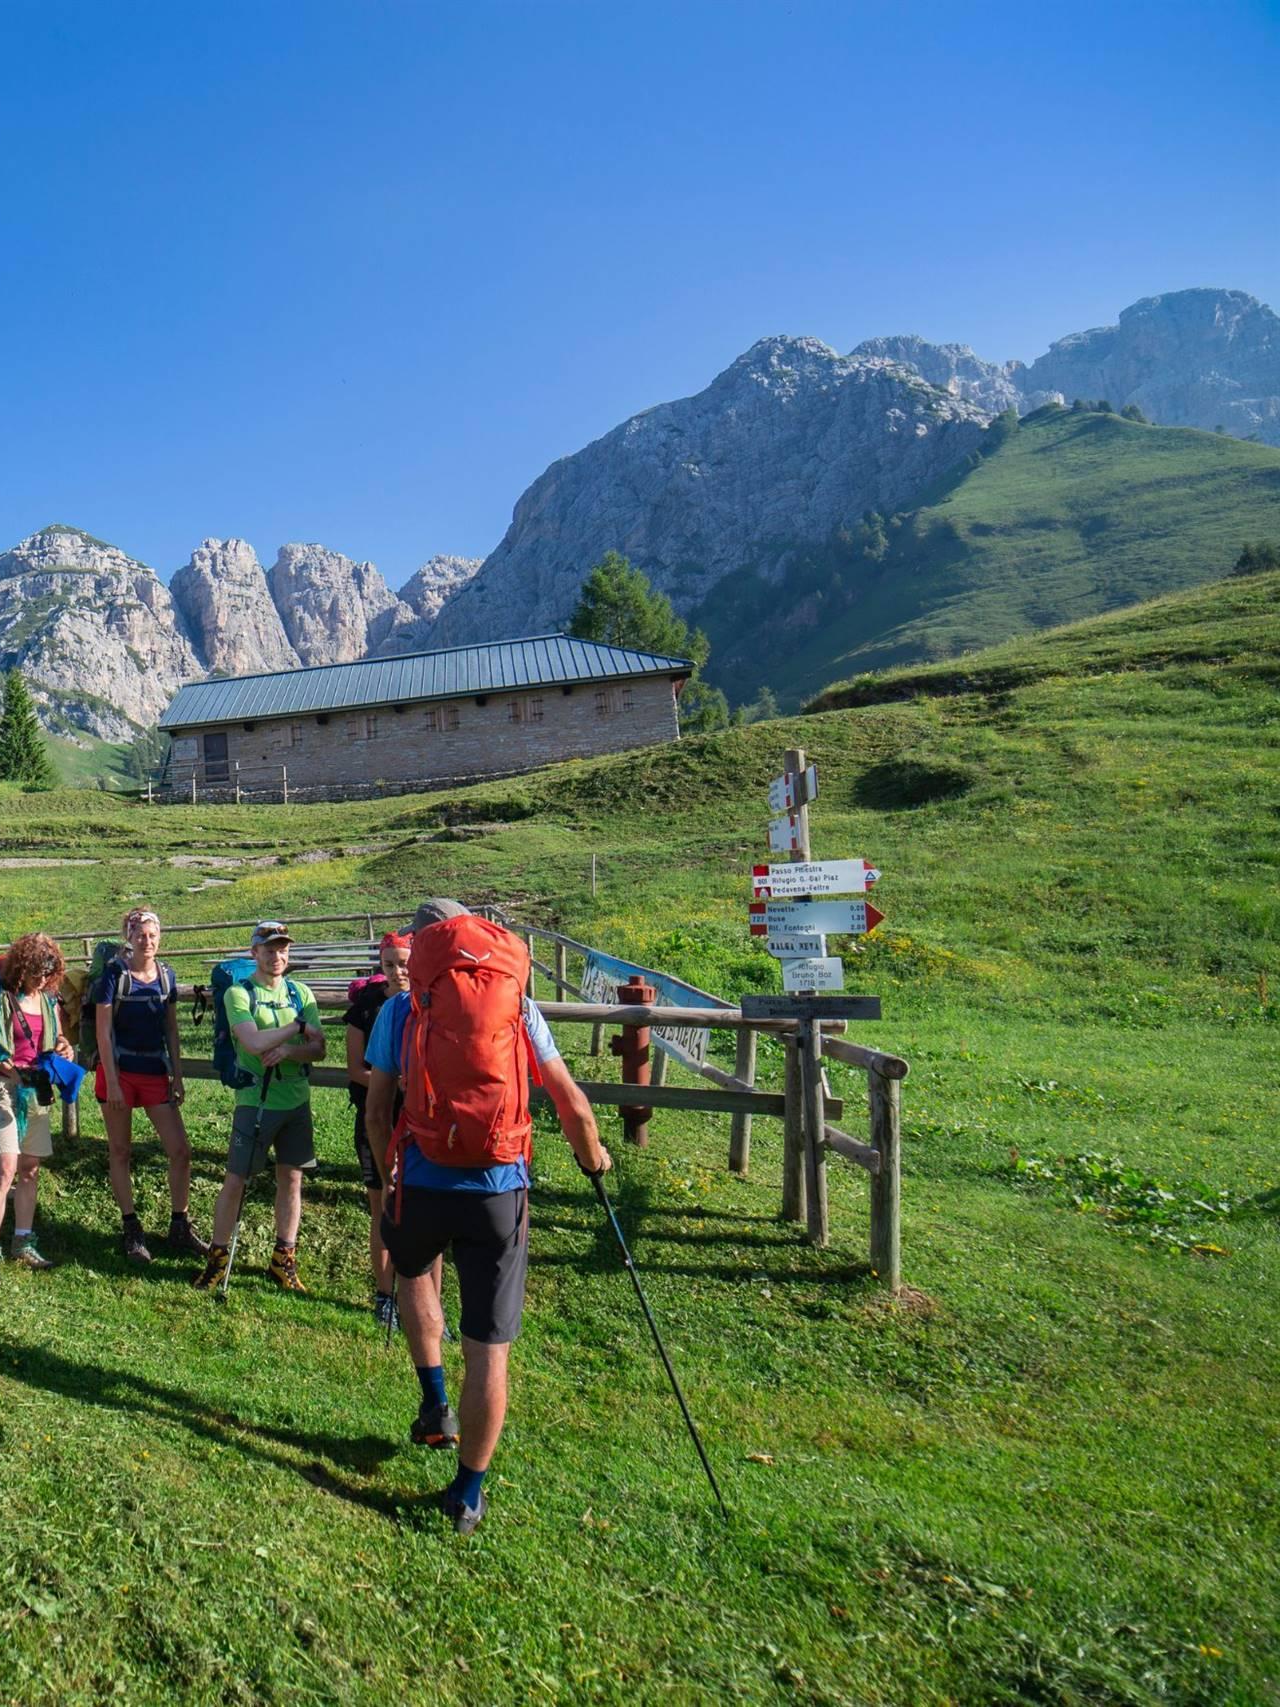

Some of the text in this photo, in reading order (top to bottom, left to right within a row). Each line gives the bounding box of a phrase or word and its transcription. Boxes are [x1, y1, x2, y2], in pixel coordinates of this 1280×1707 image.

[771, 867, 792, 875] Passo
[772, 876, 797, 885] Rifugio
[809, 874, 821, 882] Dal
[824, 873, 839, 881] Piaz
[799, 963, 825, 972] Rifugio
[792, 971, 815, 979] Bruno
